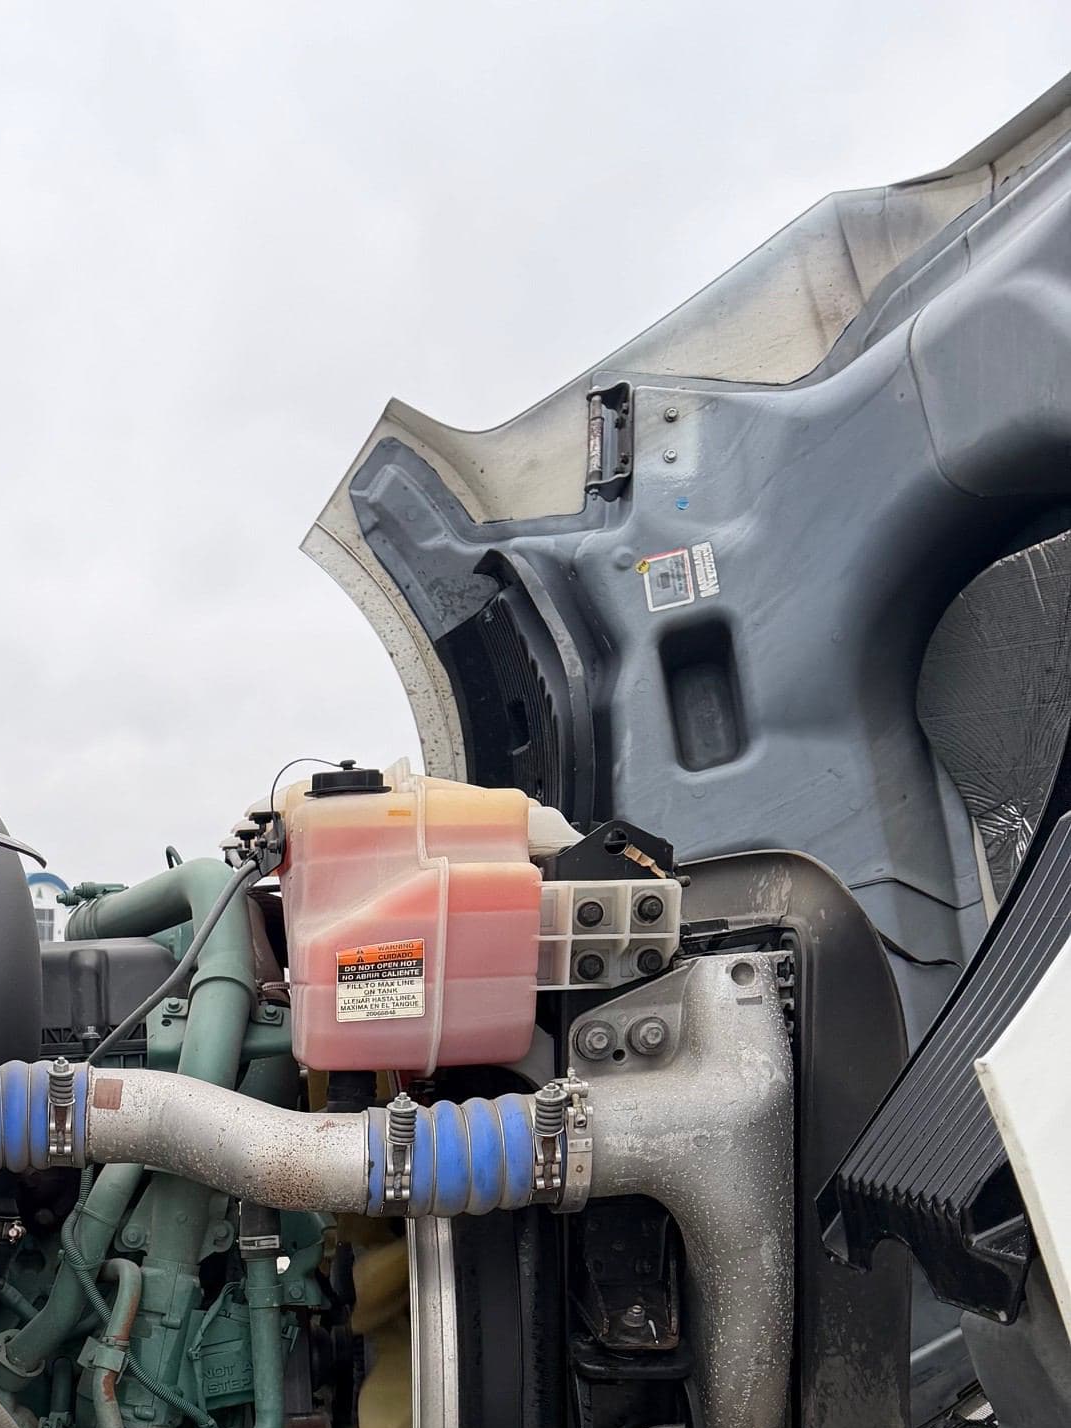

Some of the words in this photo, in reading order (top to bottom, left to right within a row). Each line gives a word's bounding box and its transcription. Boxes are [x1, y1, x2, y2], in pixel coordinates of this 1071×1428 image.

[378, 942, 415, 951] WARNING
[378, 951, 414, 961] CUIDADO
[358, 963, 375, 971] NOT
[377, 961, 399, 969] OPEN
[356, 972, 380, 980] ABRIR
[381, 968, 420, 978] CALIENTE
[343, 997, 370, 1005] LLENAR
[392, 1000, 419, 1008] TANQUE
[203, 1364, 237, 1380] NOT
[208, 1377, 252, 1395] STEP
